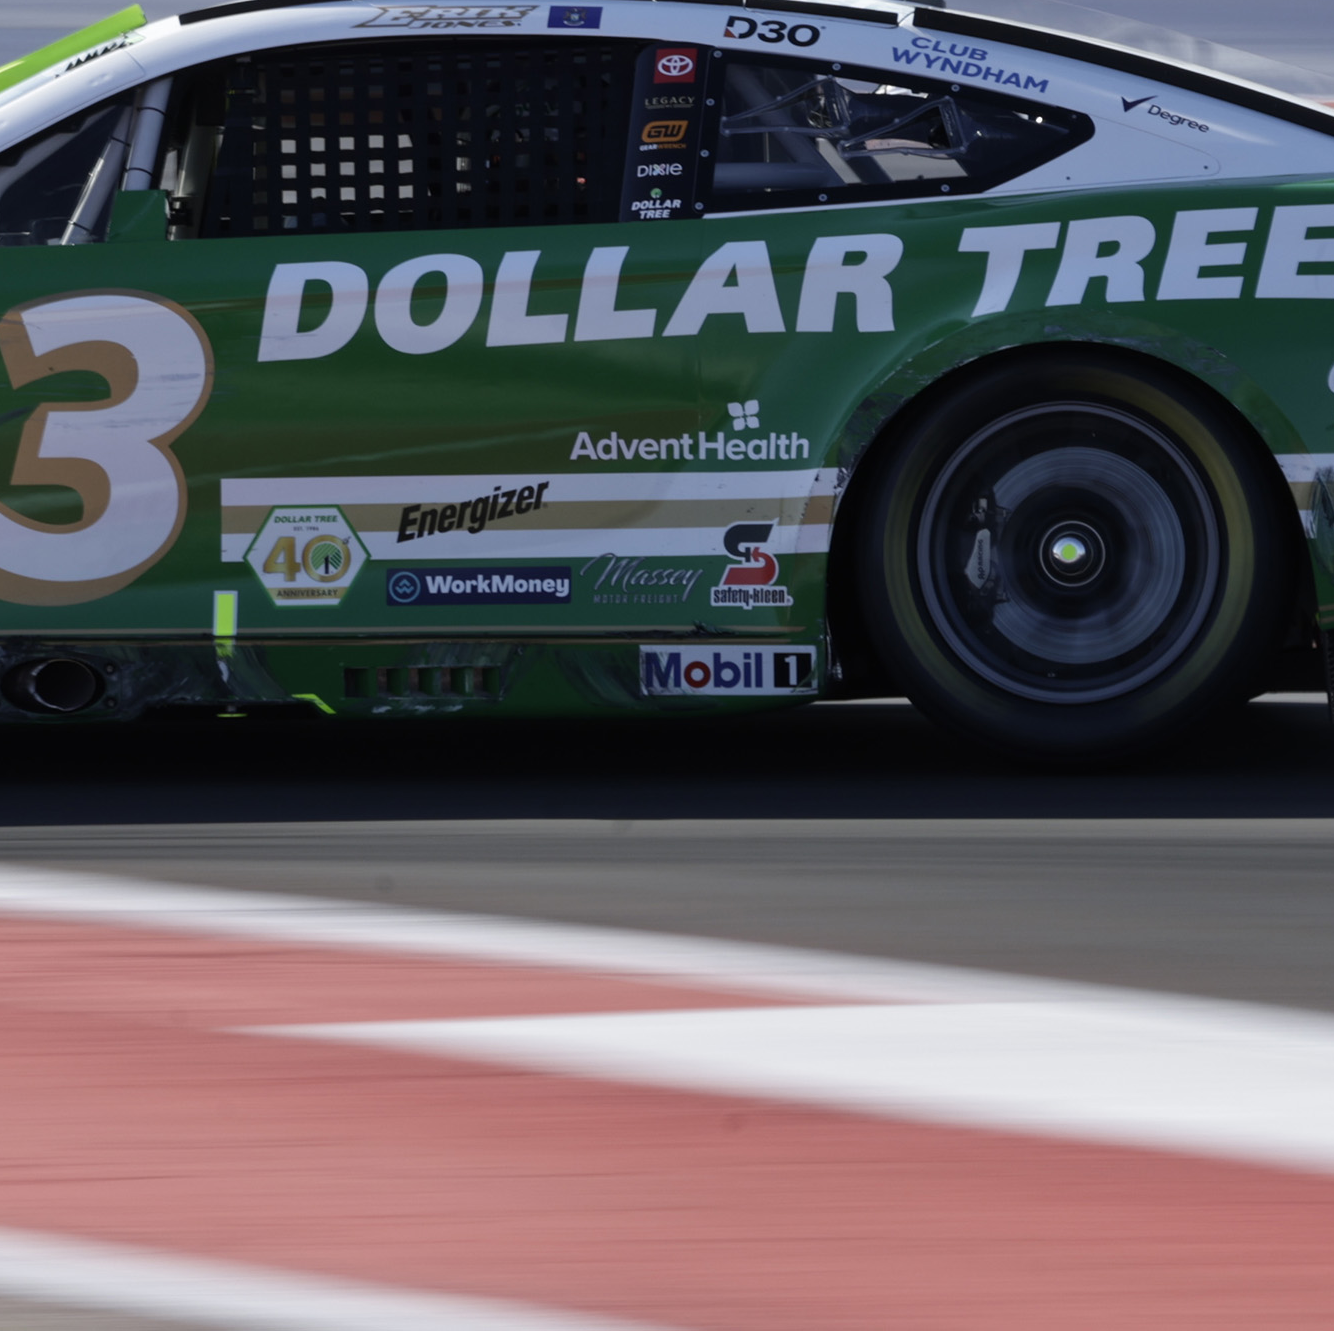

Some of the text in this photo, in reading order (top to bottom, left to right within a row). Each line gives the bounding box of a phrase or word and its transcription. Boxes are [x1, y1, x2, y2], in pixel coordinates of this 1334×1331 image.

[724, 16, 821, 47] D30
[911, 37, 989, 62] CLUB
[891, 47, 1049, 93] WYNDHAM
[644, 96, 694, 105] LEGACY
[1147, 104, 1210, 133] Degree
[631, 199, 682, 211] DOLLAR
[640, 210, 671, 219] TREE
[257, 233, 904, 362] DOLLAR
[274, 515, 338, 524] DOLLAR TREE
[396, 480, 549, 544] Energizer
[263, 534, 351, 583] 40
[425, 574, 570, 598] WorkMoney
[579, 552, 704, 602] Massey
[276, 589, 339, 598] ANNIVERSARY
[593, 594, 679, 604] MOTOR FREIGHT
[713, 587, 786, 607] safety-kleen
[644, 652, 798, 688] Mobil 1
